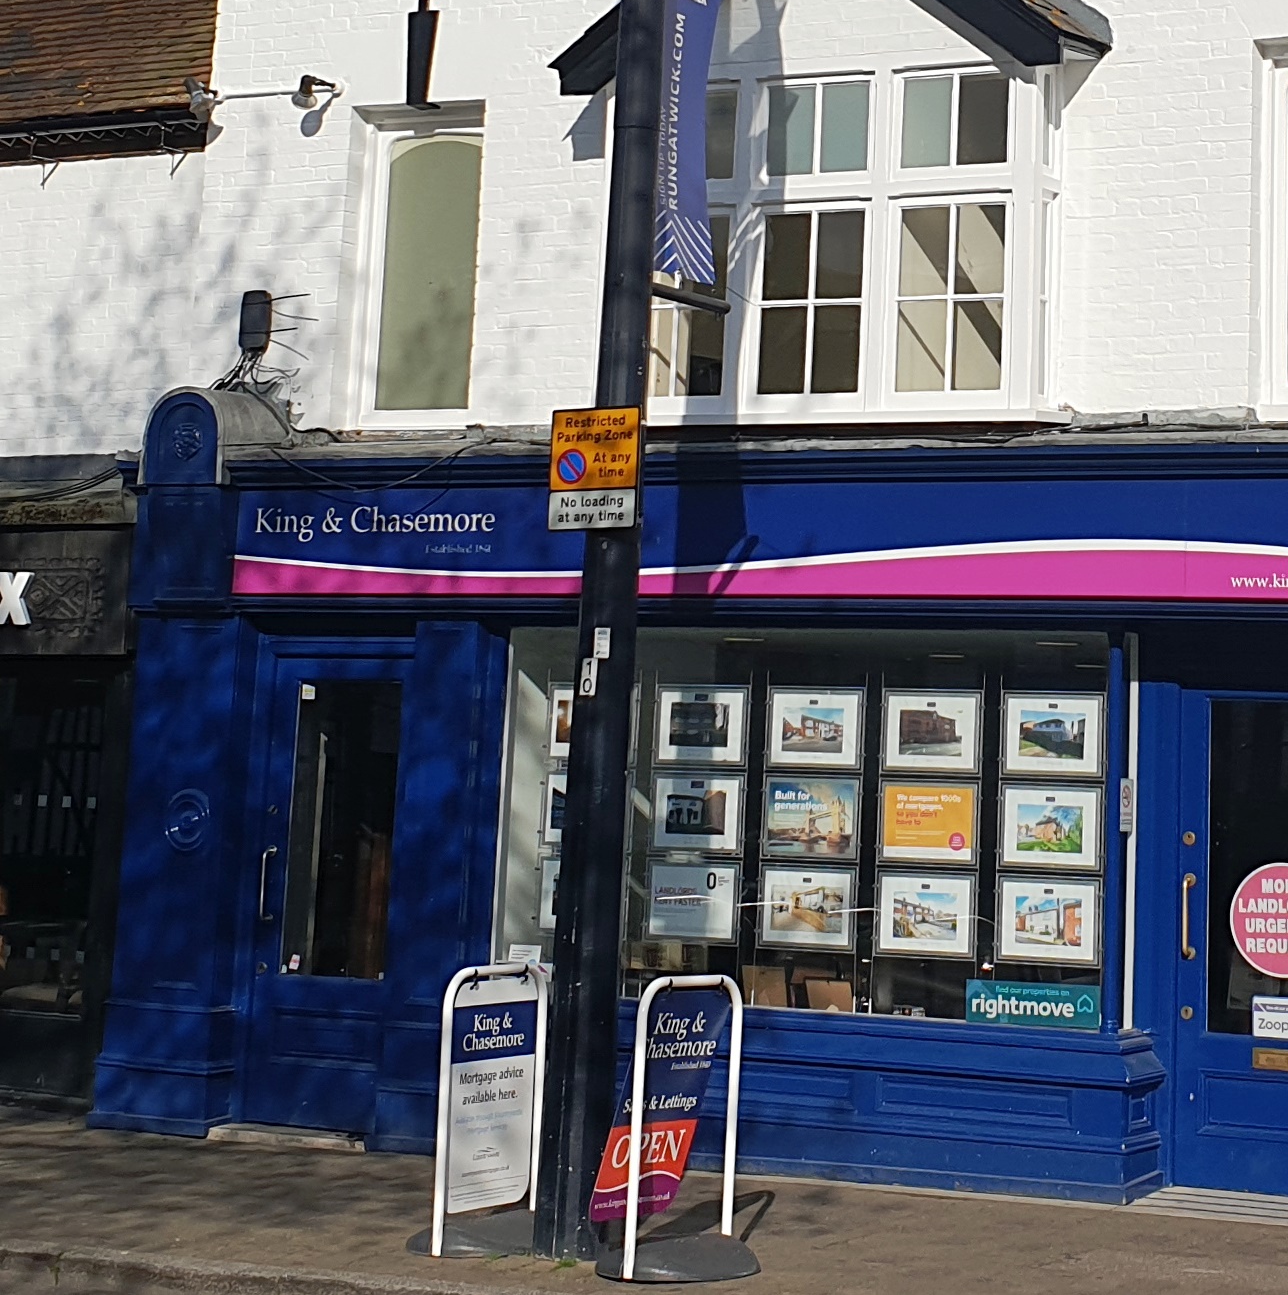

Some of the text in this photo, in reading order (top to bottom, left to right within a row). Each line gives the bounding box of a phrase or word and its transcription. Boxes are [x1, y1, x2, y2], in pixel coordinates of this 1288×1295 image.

[667, 12, 686, 211] RUNGATWICK.COM
[565, 414, 627, 428] Restricted
[557, 429, 634, 444] Parking Zone
[592, 452, 631, 464] At any
[598, 466, 625, 478] time
[560, 494, 624, 508] No loading
[255, 506, 496, 543] King & Chasemore
[557, 509, 625, 524] at any time
[774, 790, 811, 801] Built for
[971, 993, 1075, 1019] rightmove
[473, 1011, 513, 1035] King &
[653, 1010, 707, 1041] King &
[462, 1033, 525, 1052] Chasemore
[646, 1037, 717, 1059] hasemore
[459, 1065, 524, 1086] Mortgage advice
[462, 1088, 519, 1105] available here.
[648, 1094, 659, 1110] &
[658, 1092, 698, 1112] Lettings
